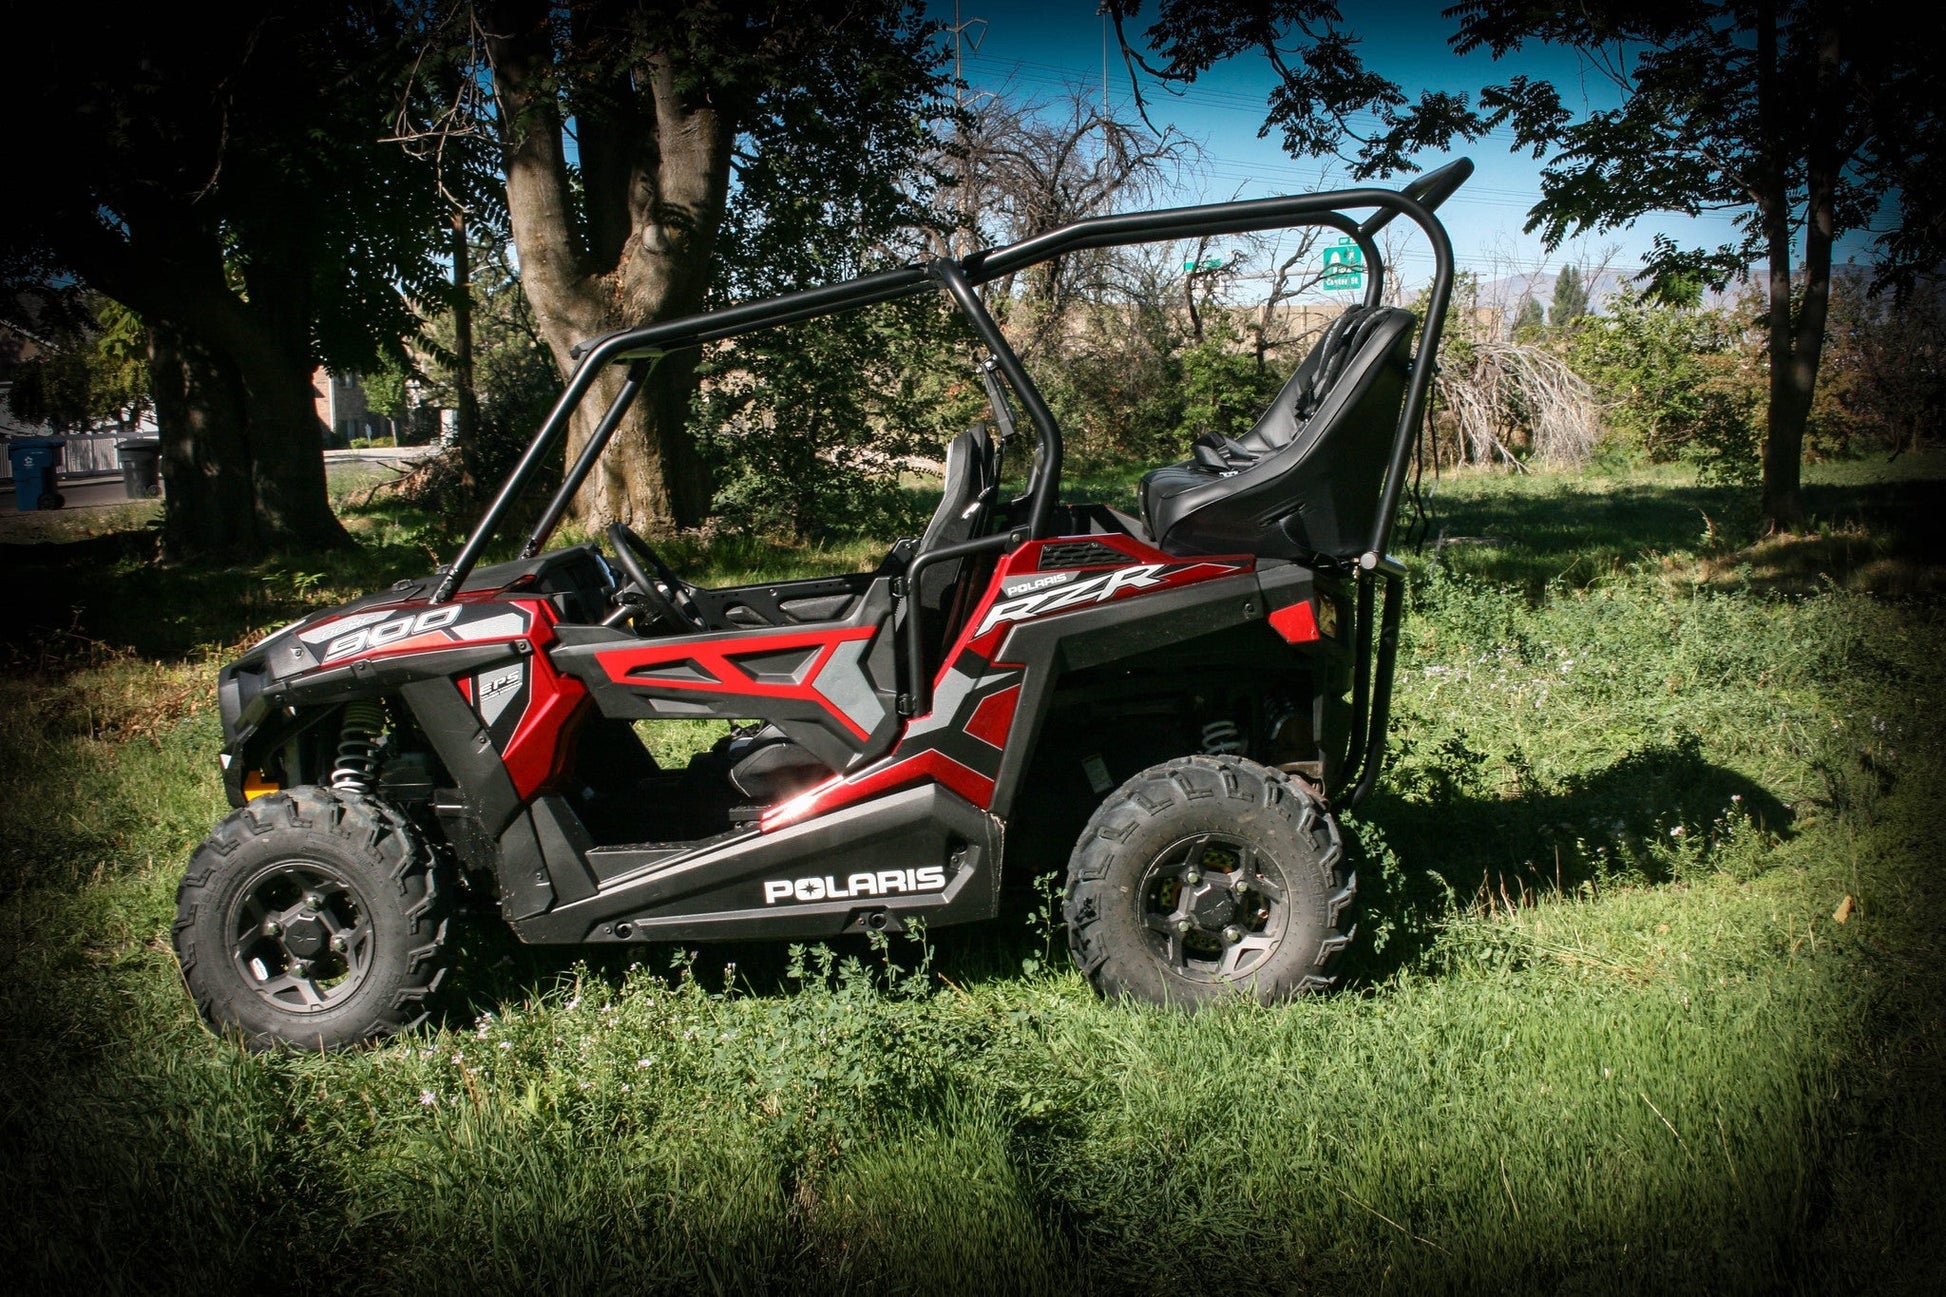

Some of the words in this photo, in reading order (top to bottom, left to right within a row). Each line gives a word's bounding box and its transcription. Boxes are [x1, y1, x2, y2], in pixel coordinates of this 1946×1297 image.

[974, 564, 1168, 637] RZR
[1007, 573, 1067, 596] POLARIS
[325, 604, 462, 661] 900
[480, 671, 519, 695] EPS
[764, 866, 946, 904] POLARIS
